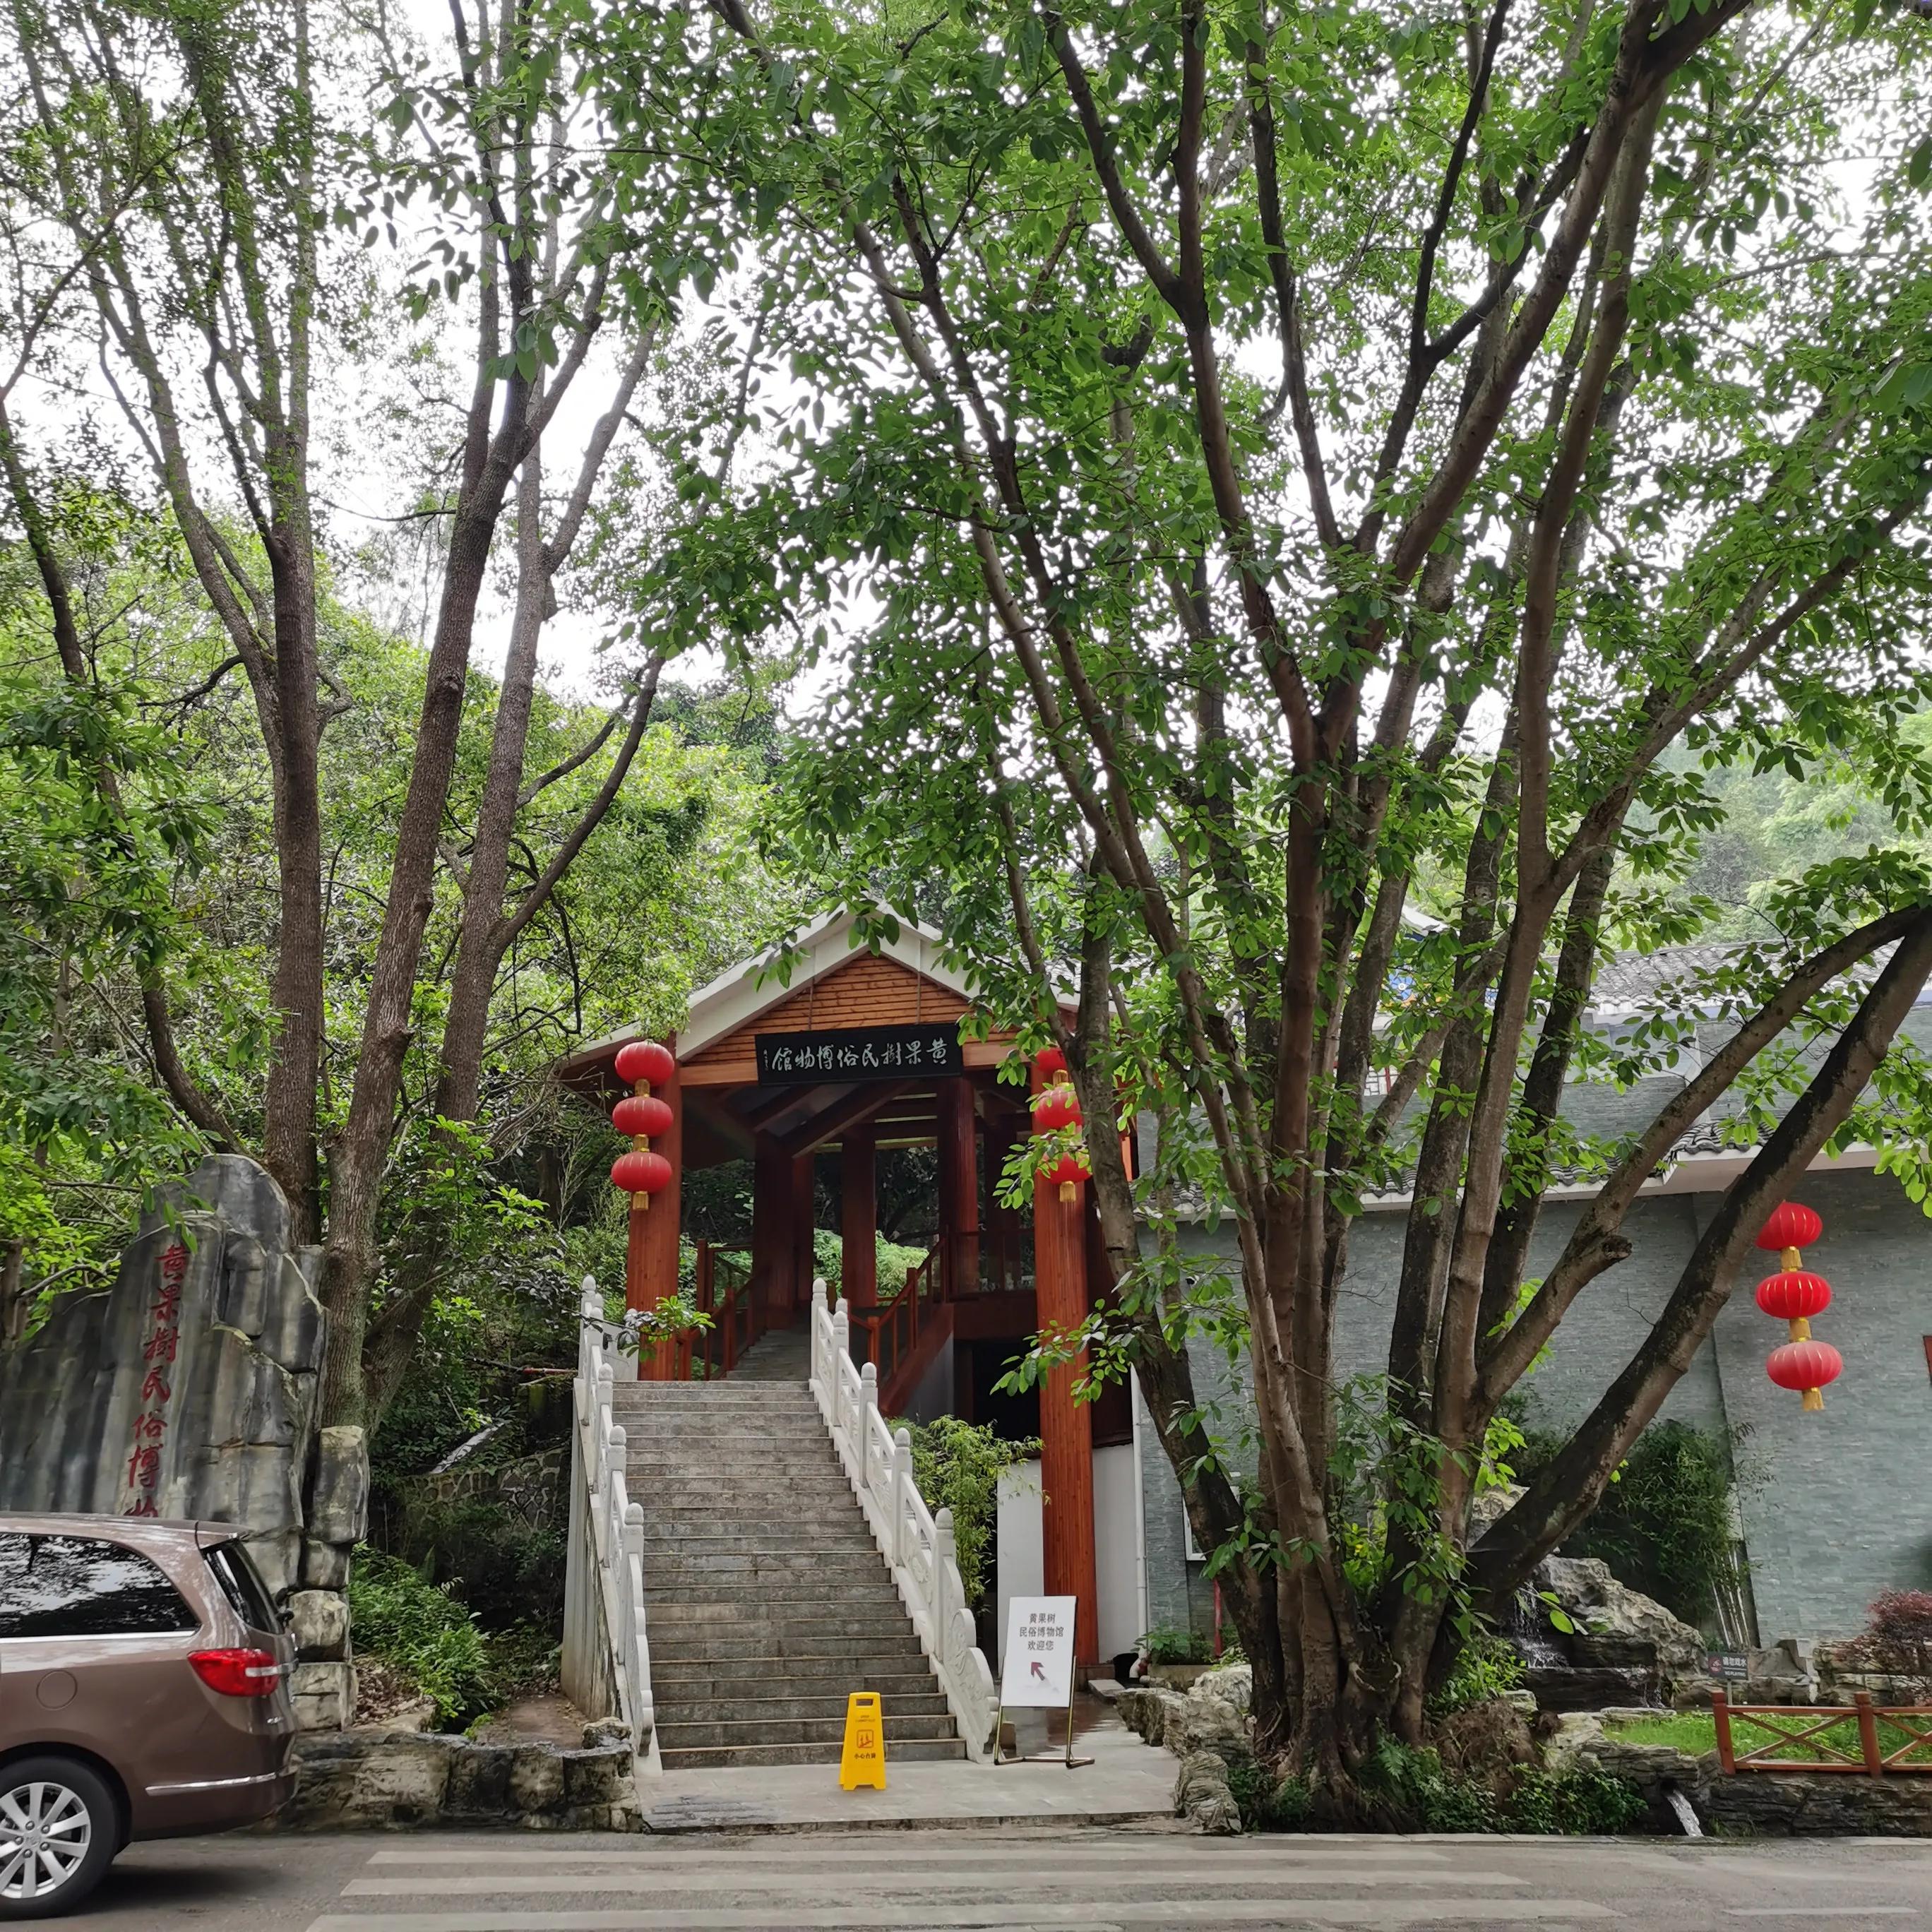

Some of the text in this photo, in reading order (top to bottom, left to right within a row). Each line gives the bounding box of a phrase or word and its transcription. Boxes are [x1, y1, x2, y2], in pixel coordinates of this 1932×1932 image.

[1029, 1613, 1056, 1624] 黄果树
[1019, 1626, 1064, 1638] 民俗博物馆
[1027, 1640, 1054, 1651] 欢迎您
